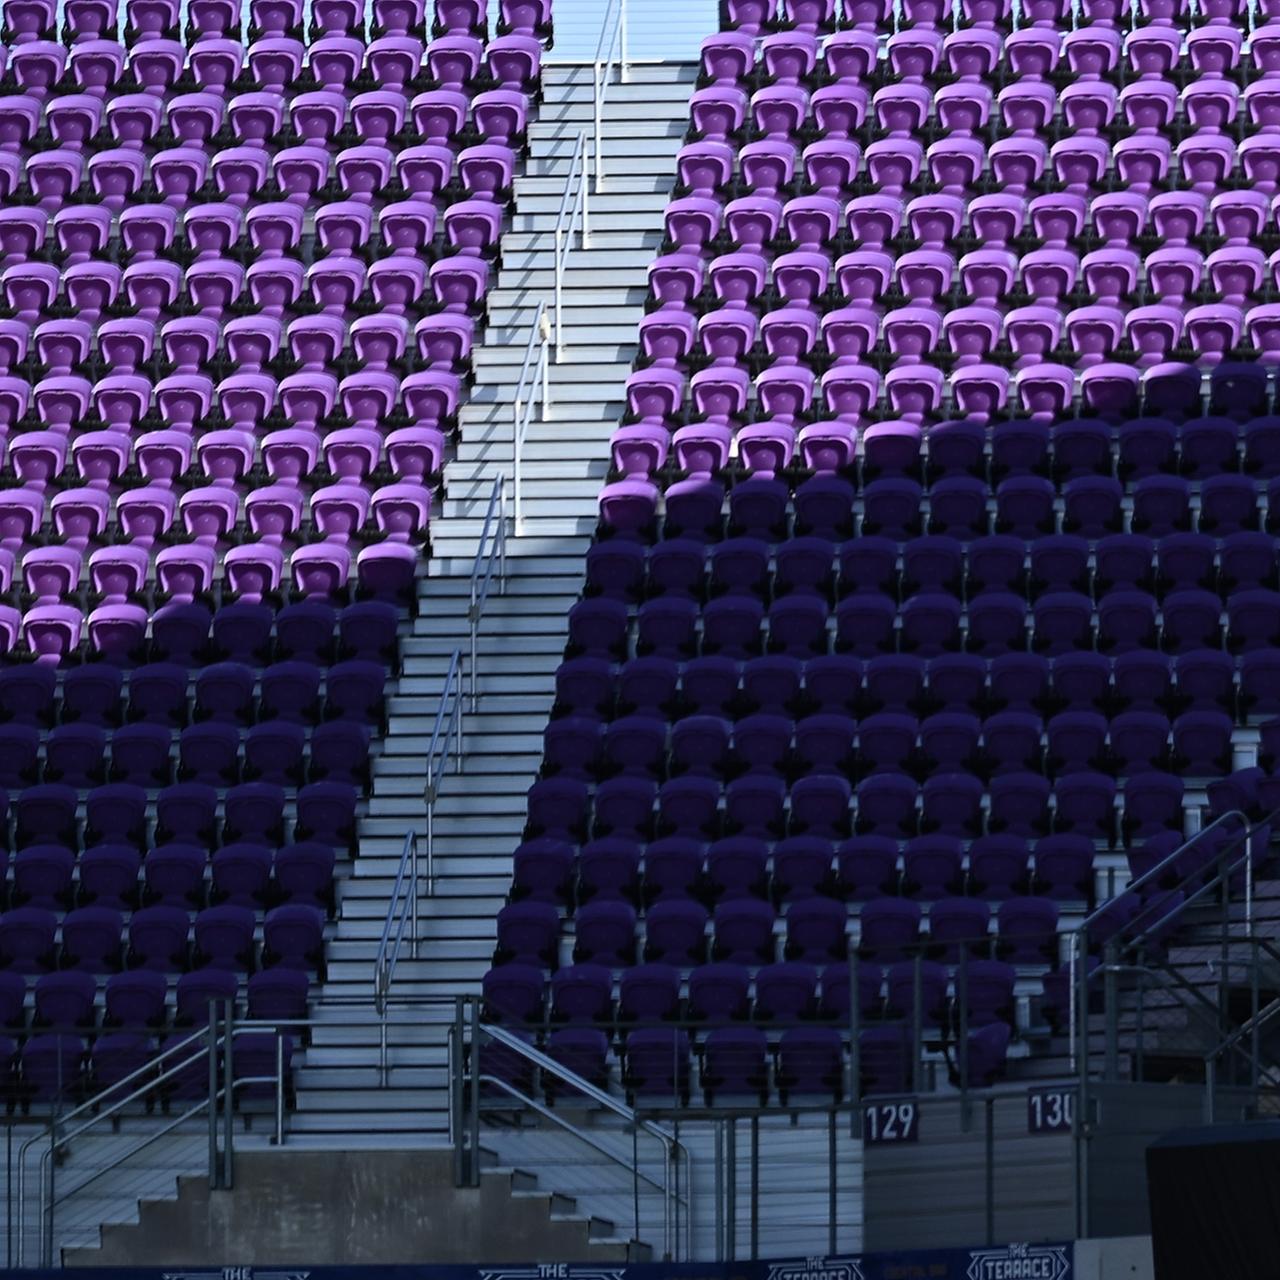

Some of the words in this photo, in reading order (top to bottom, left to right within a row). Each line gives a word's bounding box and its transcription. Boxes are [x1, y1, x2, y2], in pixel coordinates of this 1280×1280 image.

[867, 1104, 913, 1141] 129
[537, 1263, 568, 1278] THE
[805, 1256, 825, 1270] THE
[985, 1258, 1050, 1280] TERRACE
